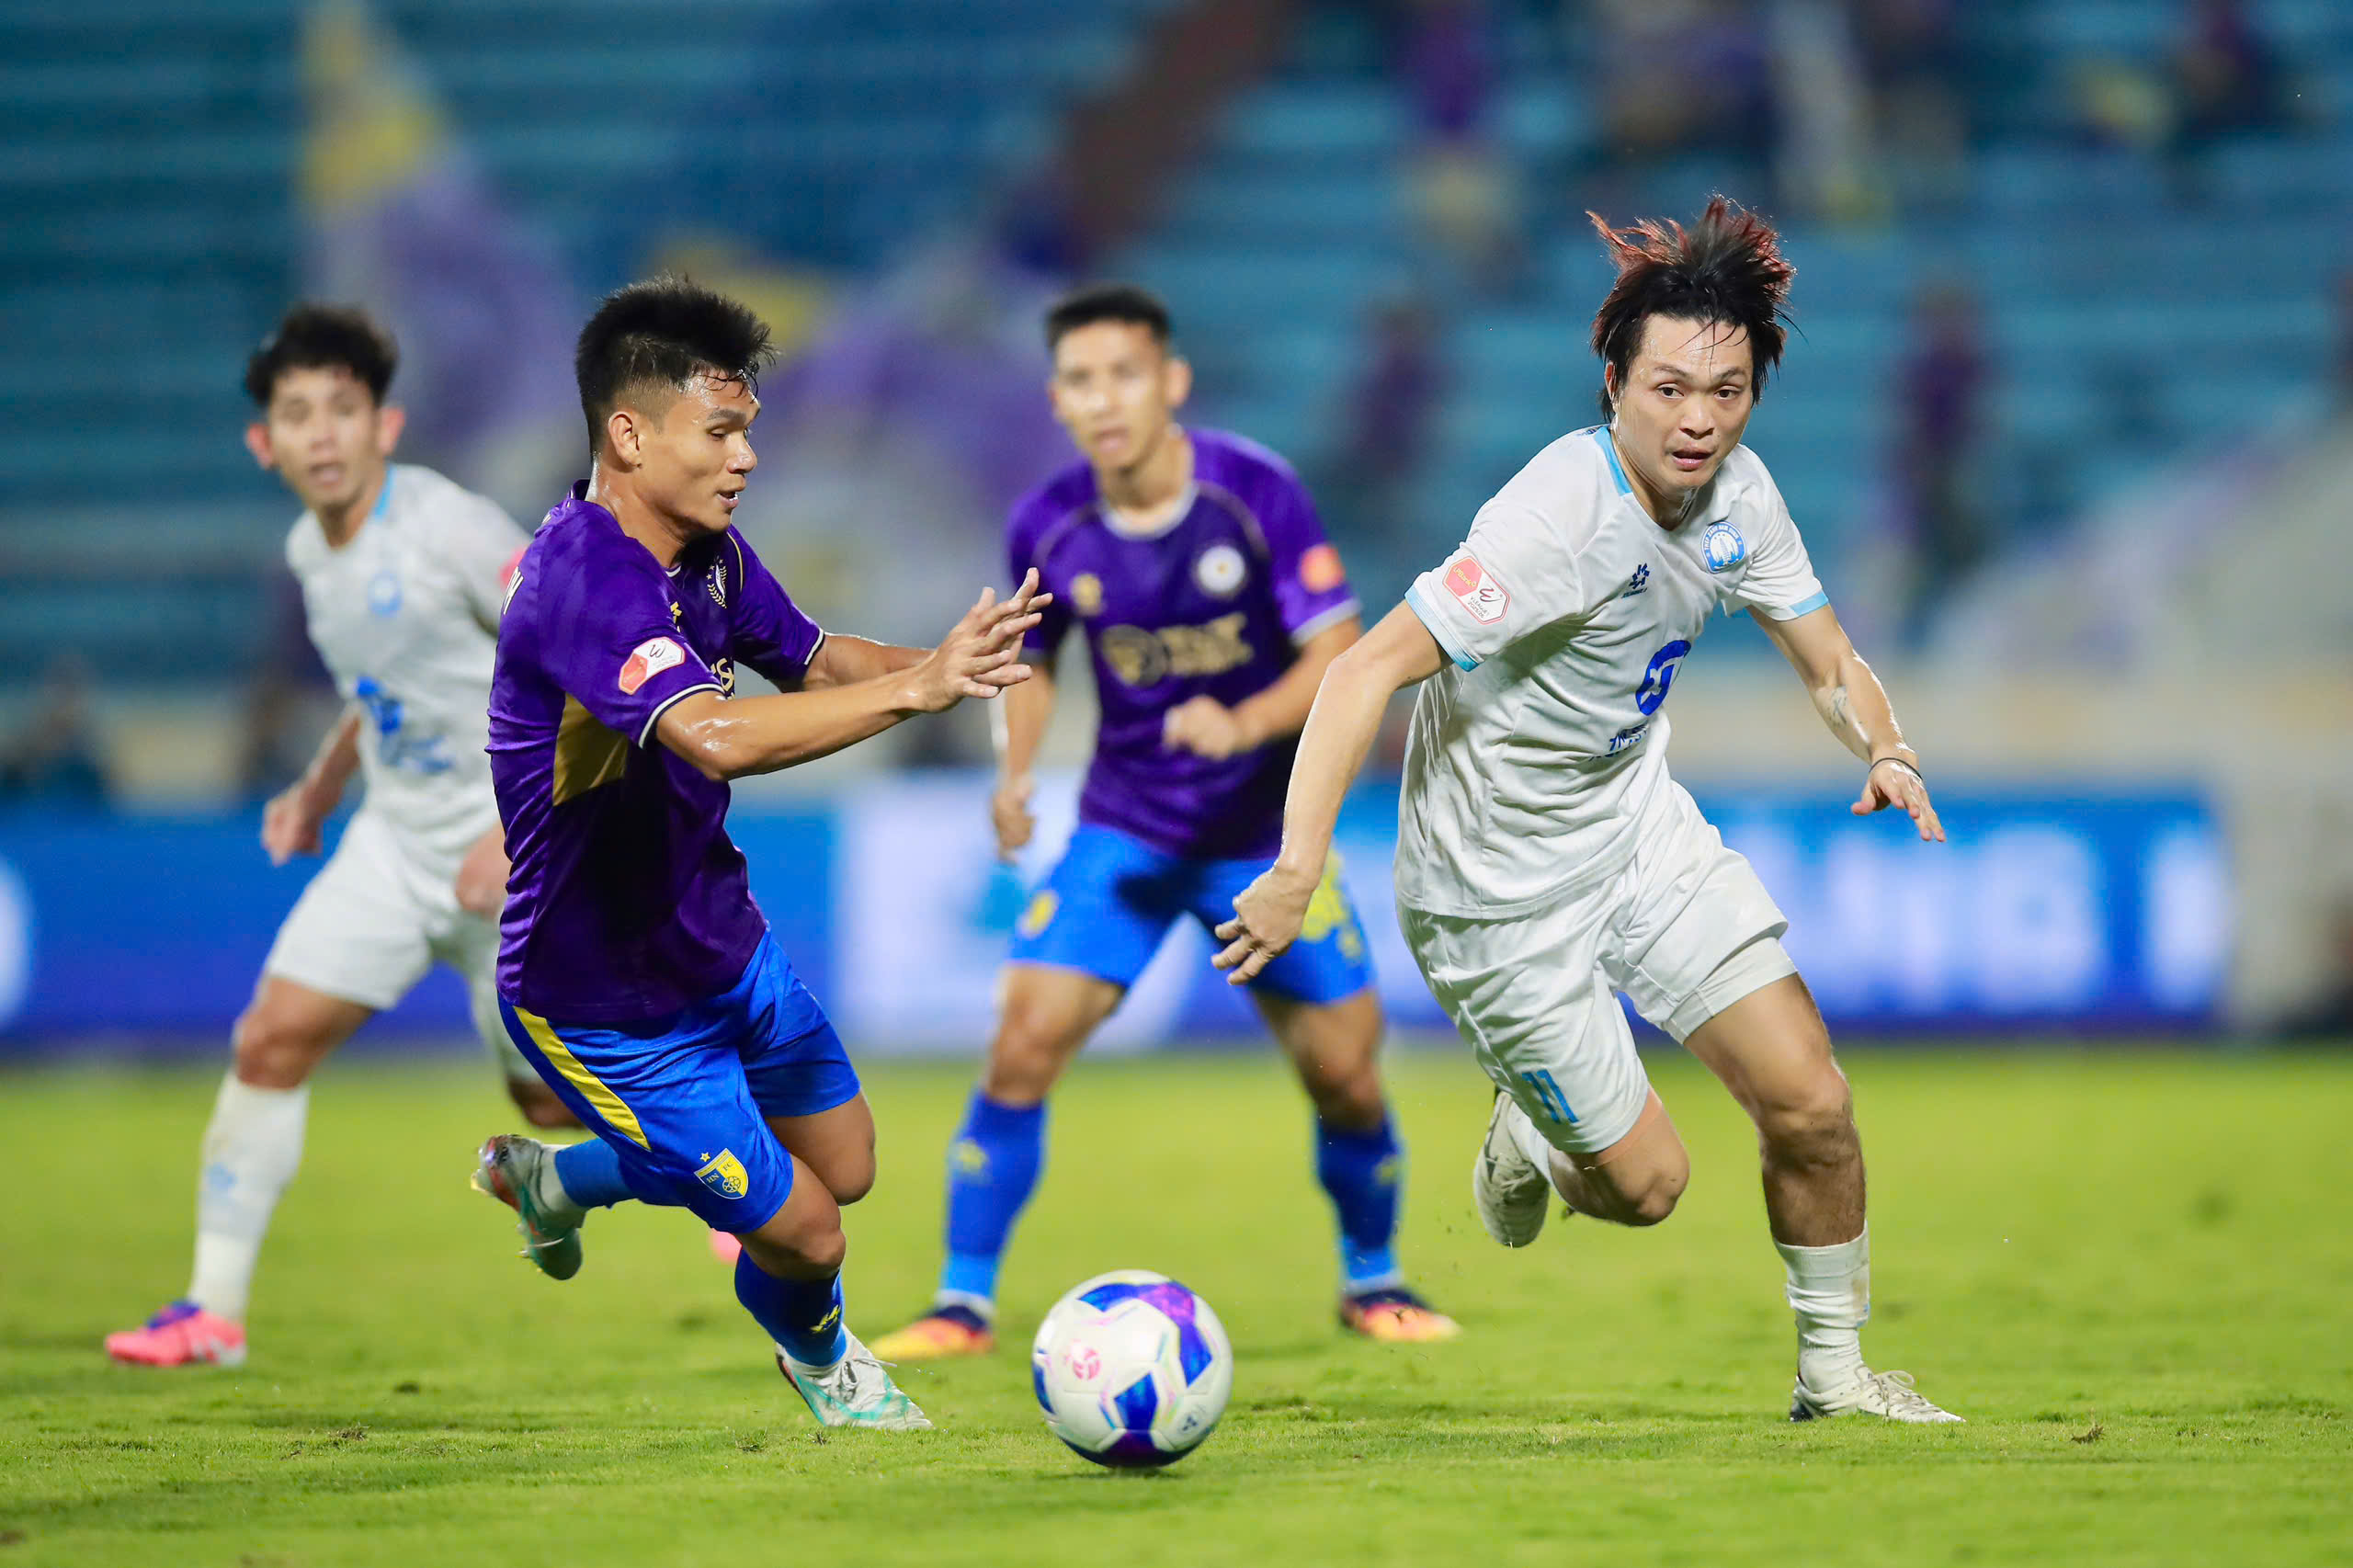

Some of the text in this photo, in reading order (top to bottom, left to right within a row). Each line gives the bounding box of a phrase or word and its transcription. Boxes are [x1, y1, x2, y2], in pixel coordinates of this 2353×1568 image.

[1521, 1068, 1580, 1125] 11
[706, 1172, 720, 1184] HN
[722, 1161, 734, 1172] FC
